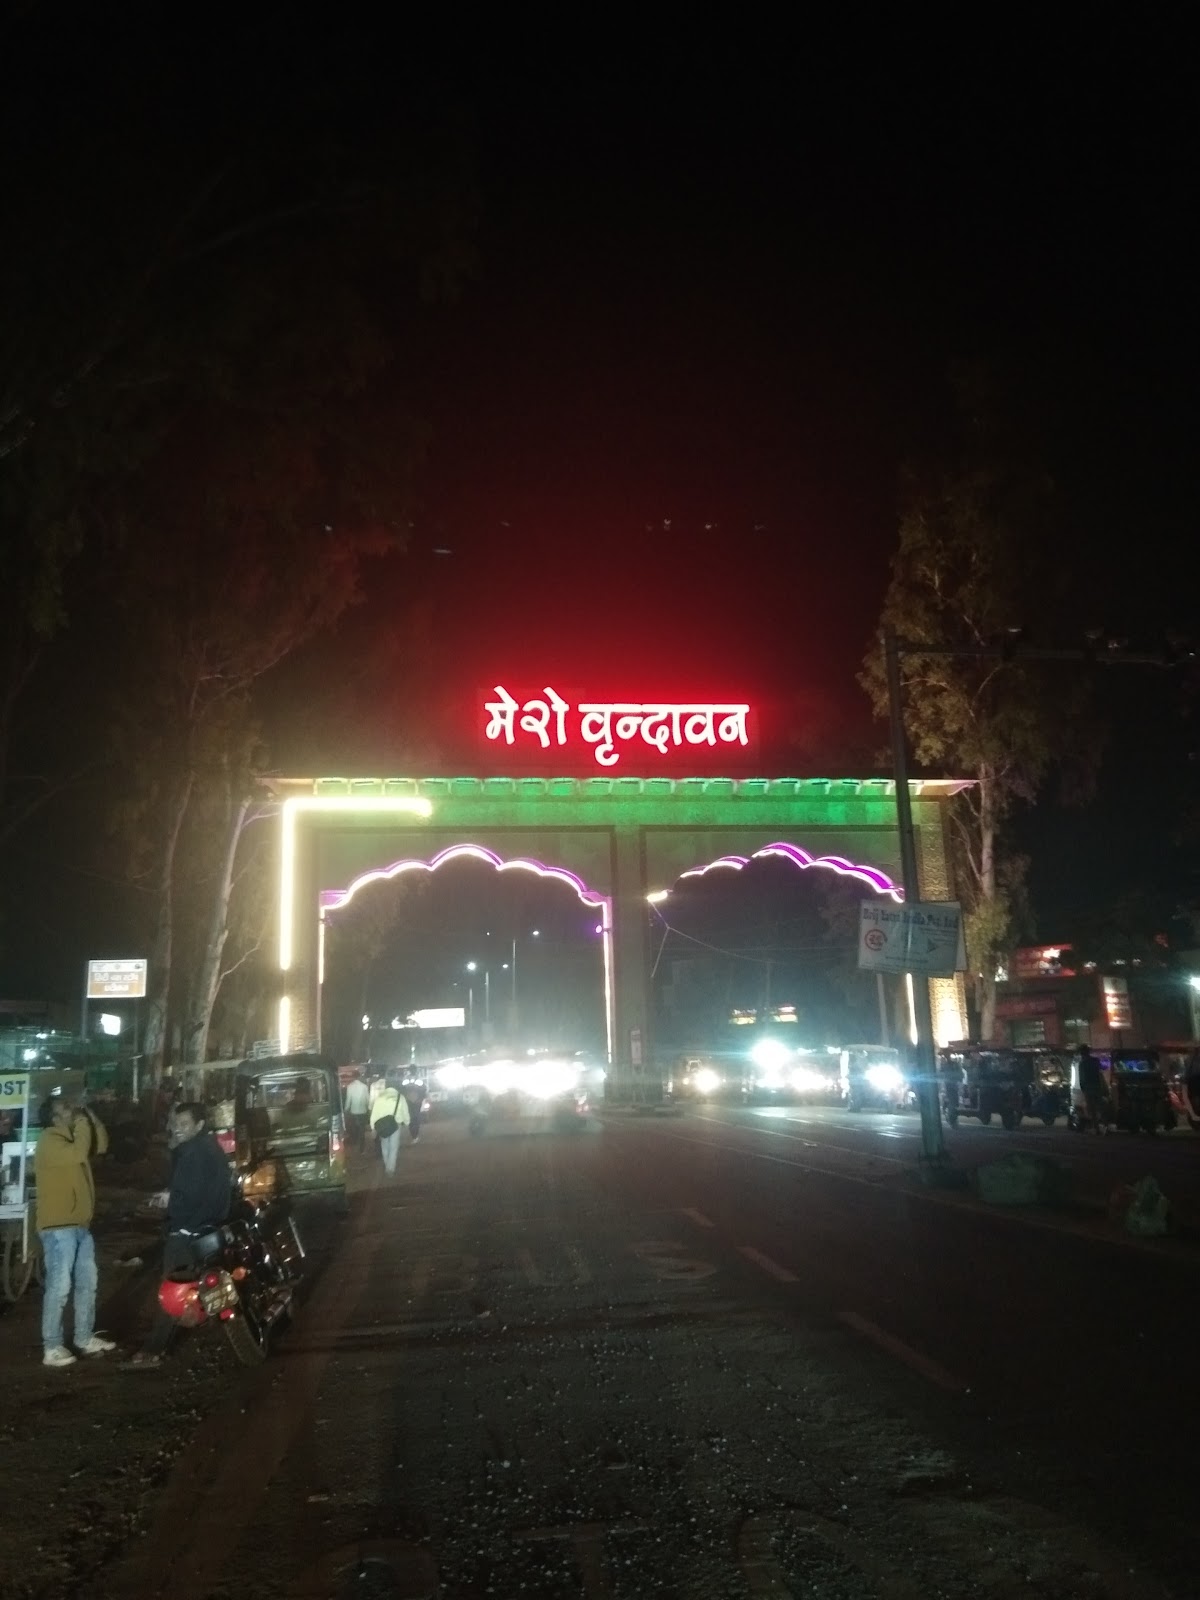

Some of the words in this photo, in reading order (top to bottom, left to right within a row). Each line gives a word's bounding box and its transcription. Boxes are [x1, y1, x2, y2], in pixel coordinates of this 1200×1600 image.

[484, 685, 569, 748] मेरो
[578, 703, 750, 766] वृन्दावन
[0, 1080, 26, 1095] ST
